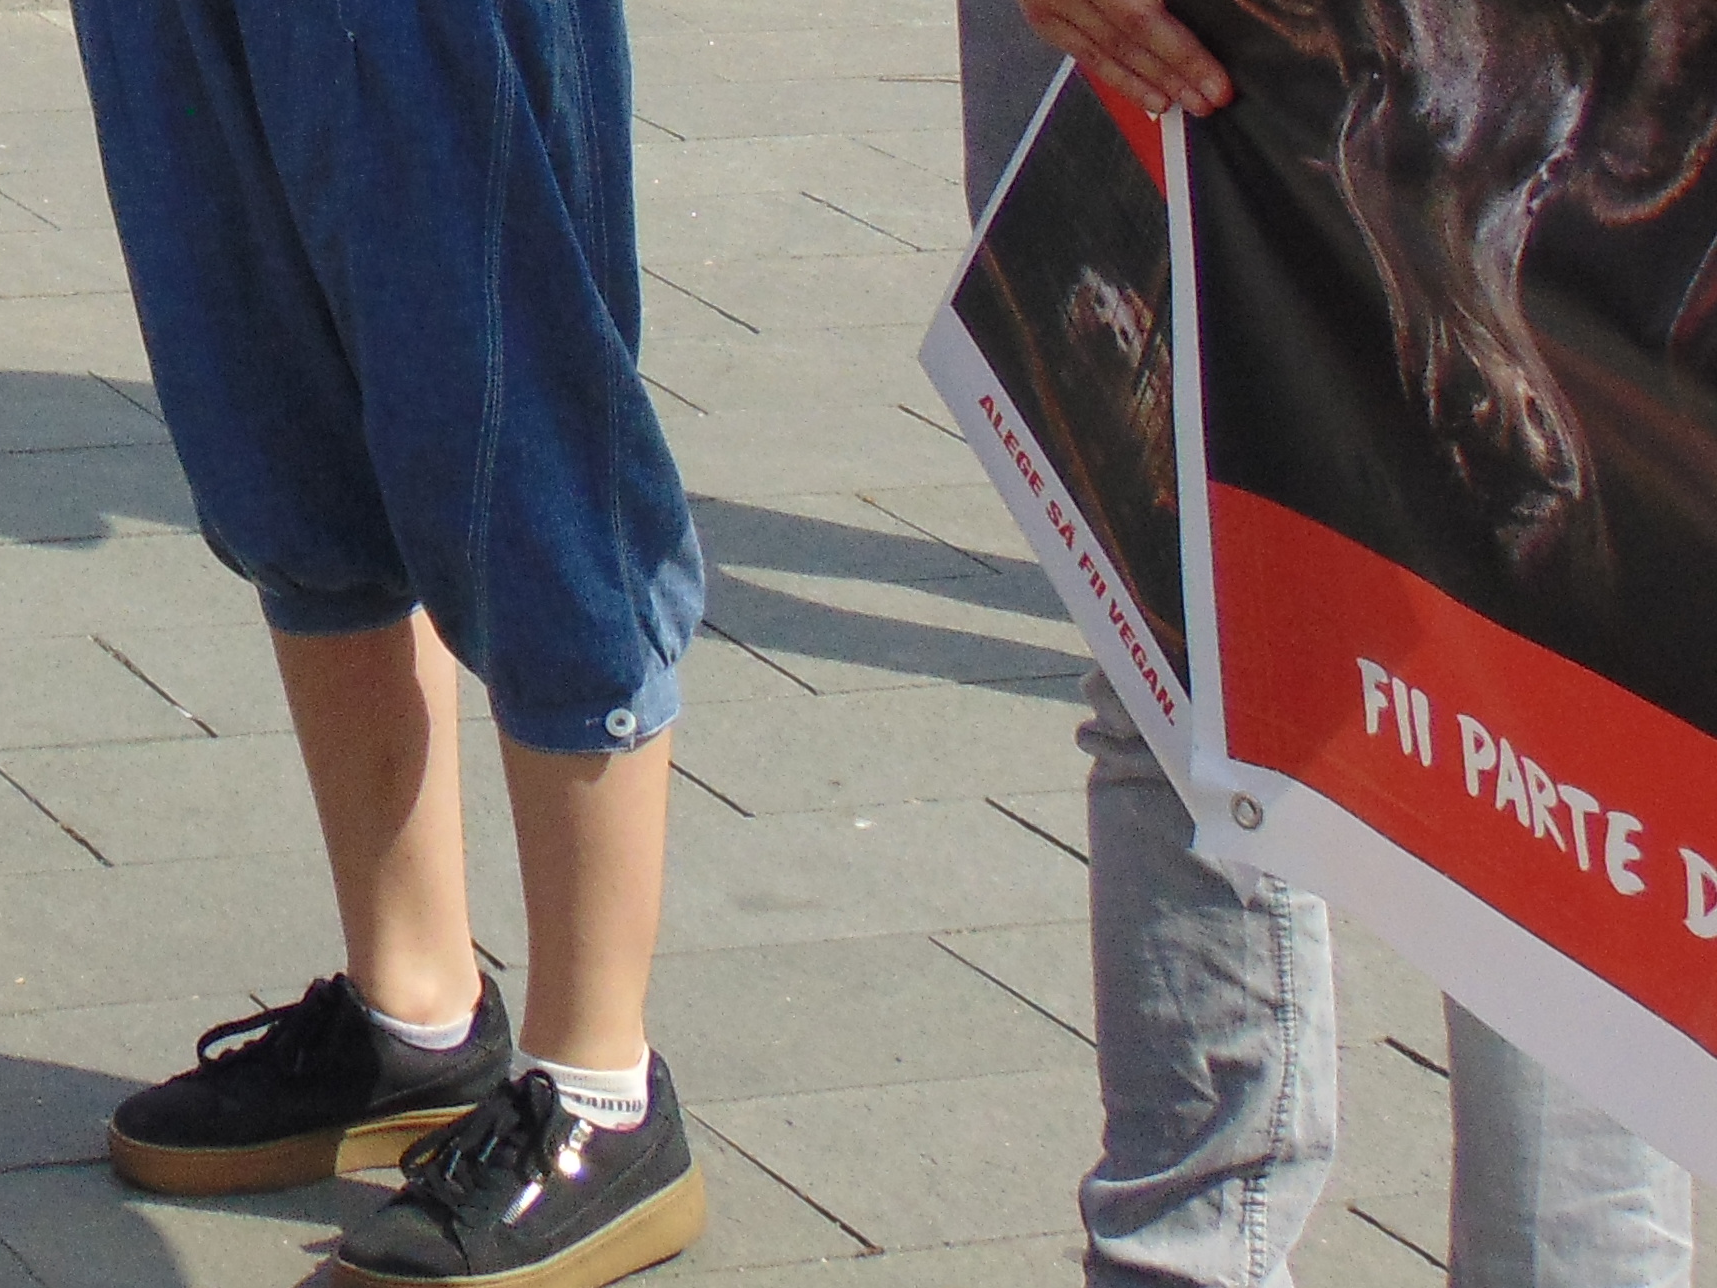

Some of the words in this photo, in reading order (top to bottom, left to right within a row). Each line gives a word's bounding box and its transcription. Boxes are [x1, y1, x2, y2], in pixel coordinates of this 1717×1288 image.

[978, 394, 1045, 498] ALEGE
[1045, 499, 1076, 551] SĂ
[1077, 551, 1108, 600] FII
[1107, 597, 1175, 727] VEGAN.
[1356, 656, 1433, 768] FII
[1455, 713, 1647, 897] PARTE
